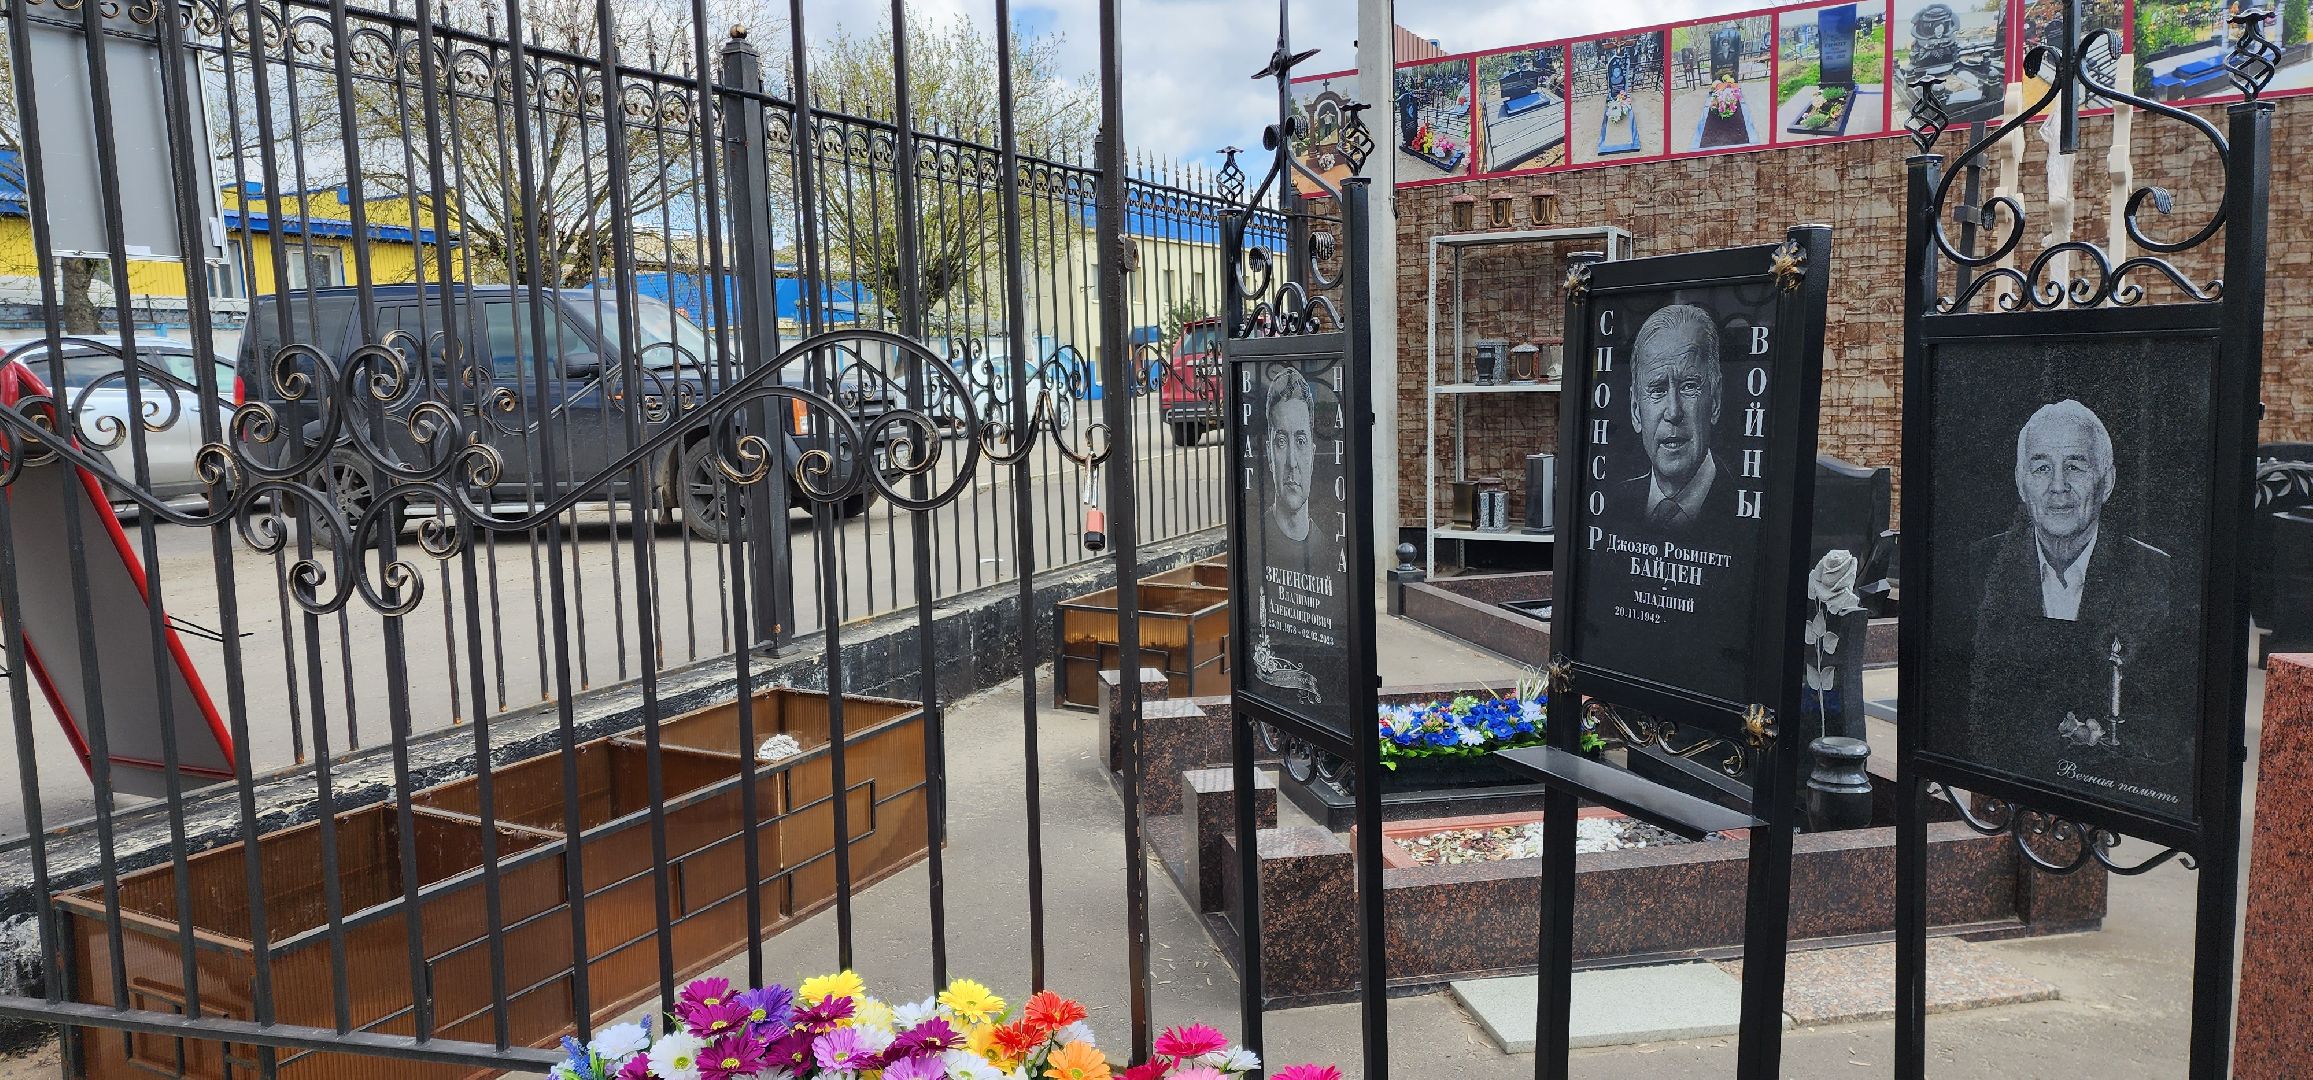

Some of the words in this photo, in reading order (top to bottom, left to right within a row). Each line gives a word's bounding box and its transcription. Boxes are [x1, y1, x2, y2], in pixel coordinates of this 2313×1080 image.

[1242, 370, 1254, 489] ВРАГ
[1587, 310, 1614, 550] СПОНСОР
[1735, 326, 1769, 519] ВОЙНЫ
[1265, 565, 1333, 597] ЗЕЛЕНСКИЙ
[1630, 556, 1703, 586] БАЙДЕН
[1614, 605, 1661, 624] 20.11.1942
[1633, 590, 1695, 613] МЛАДШИЙ
[2056, 758, 2115, 789] Вечная
[2117, 781, 2181, 805] память
